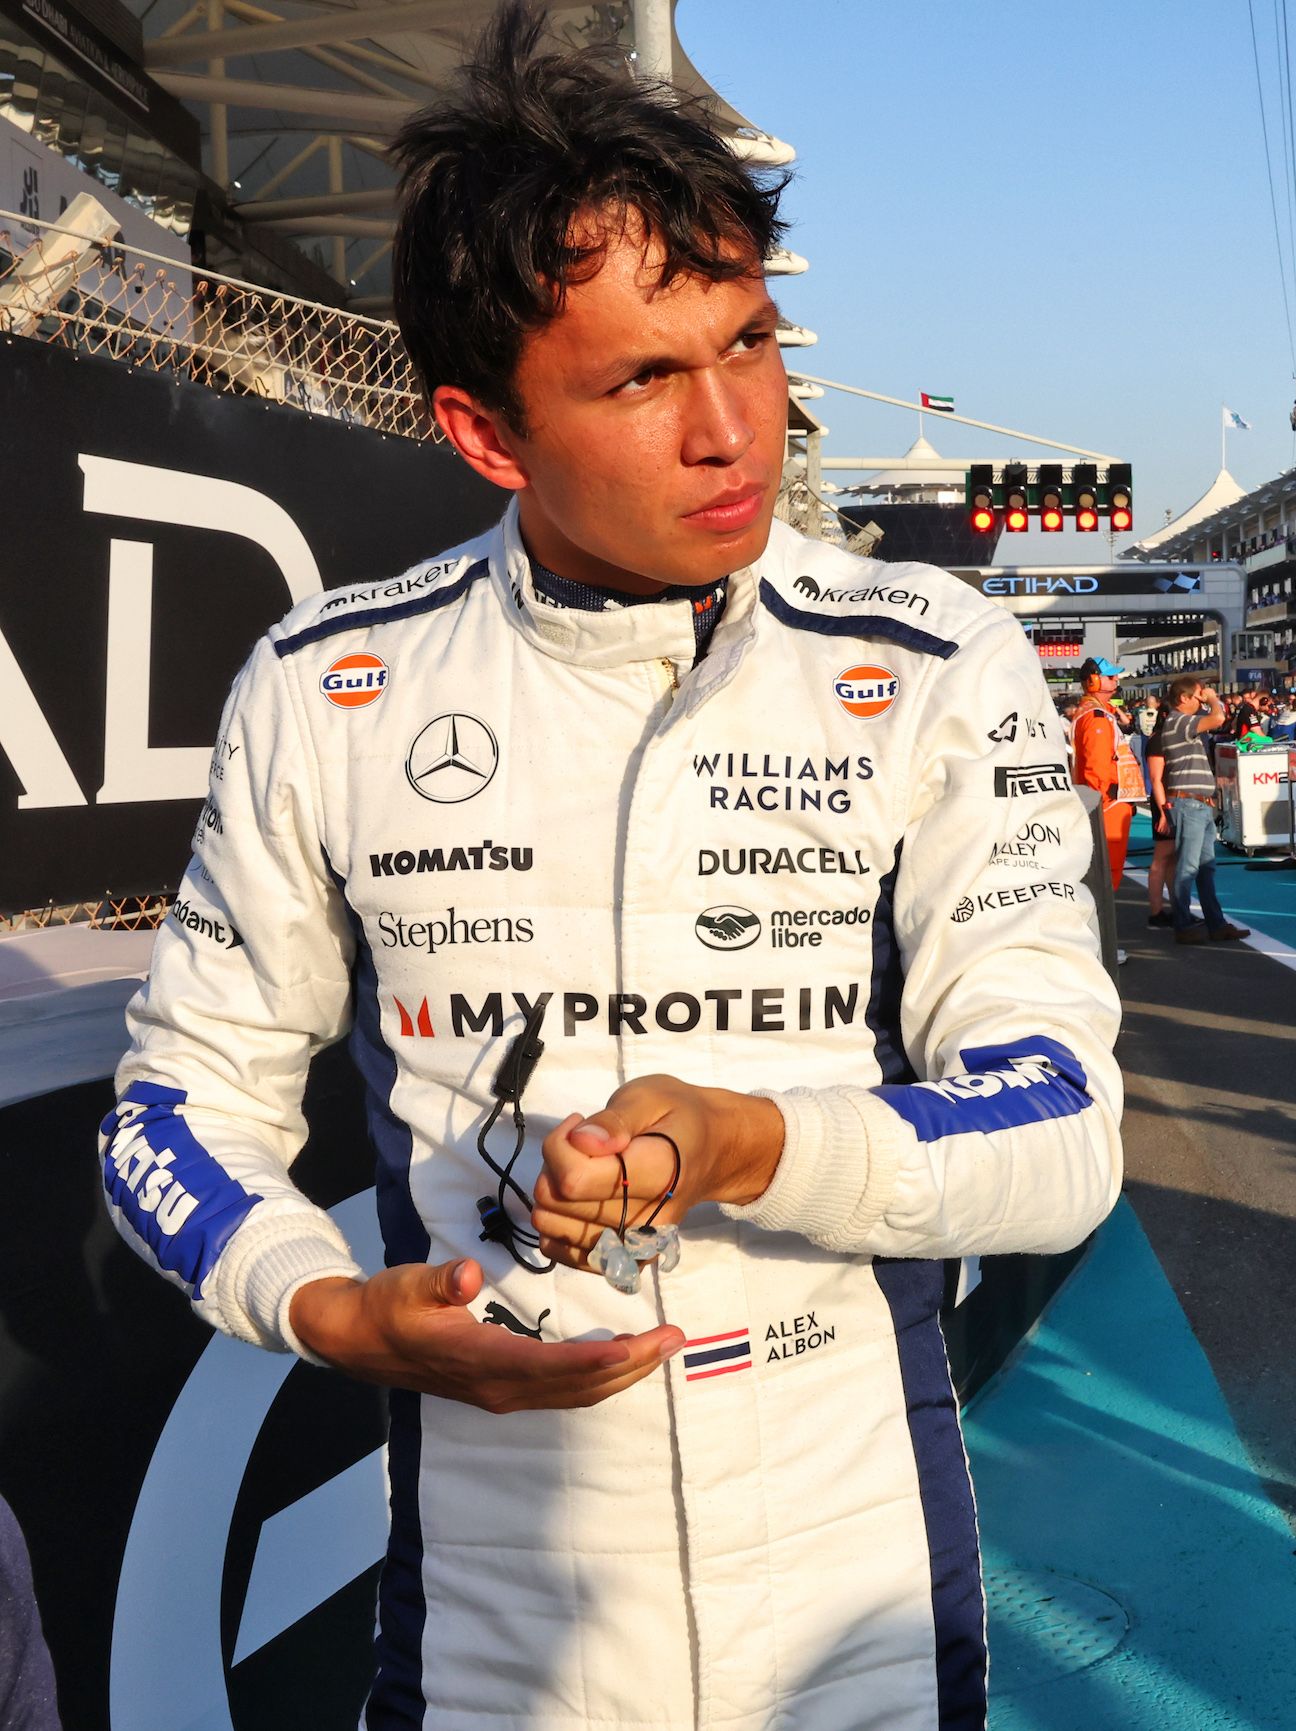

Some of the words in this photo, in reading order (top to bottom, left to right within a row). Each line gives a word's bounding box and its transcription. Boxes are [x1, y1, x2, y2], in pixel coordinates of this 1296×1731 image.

[982, 576, 1099, 594] ETIHAD
[322, 670, 387, 690] Gulf
[835, 681, 897, 699] Gulf
[693, 753, 873, 781] WILLIAMS
[710, 786, 851, 814] RACING
[369, 840, 533, 877] KOMATSU
[698, 848, 870, 875] DURACELL
[977, 882, 1075, 912] KEEPER
[771, 906, 871, 926] mercado
[378, 907, 534, 954] Stephens
[771, 928, 823, 948] libre
[450, 983, 859, 1038] MYPROTEIN
[764, 1311, 819, 1343] ALEX
[766, 1326, 836, 1364] ALBON
